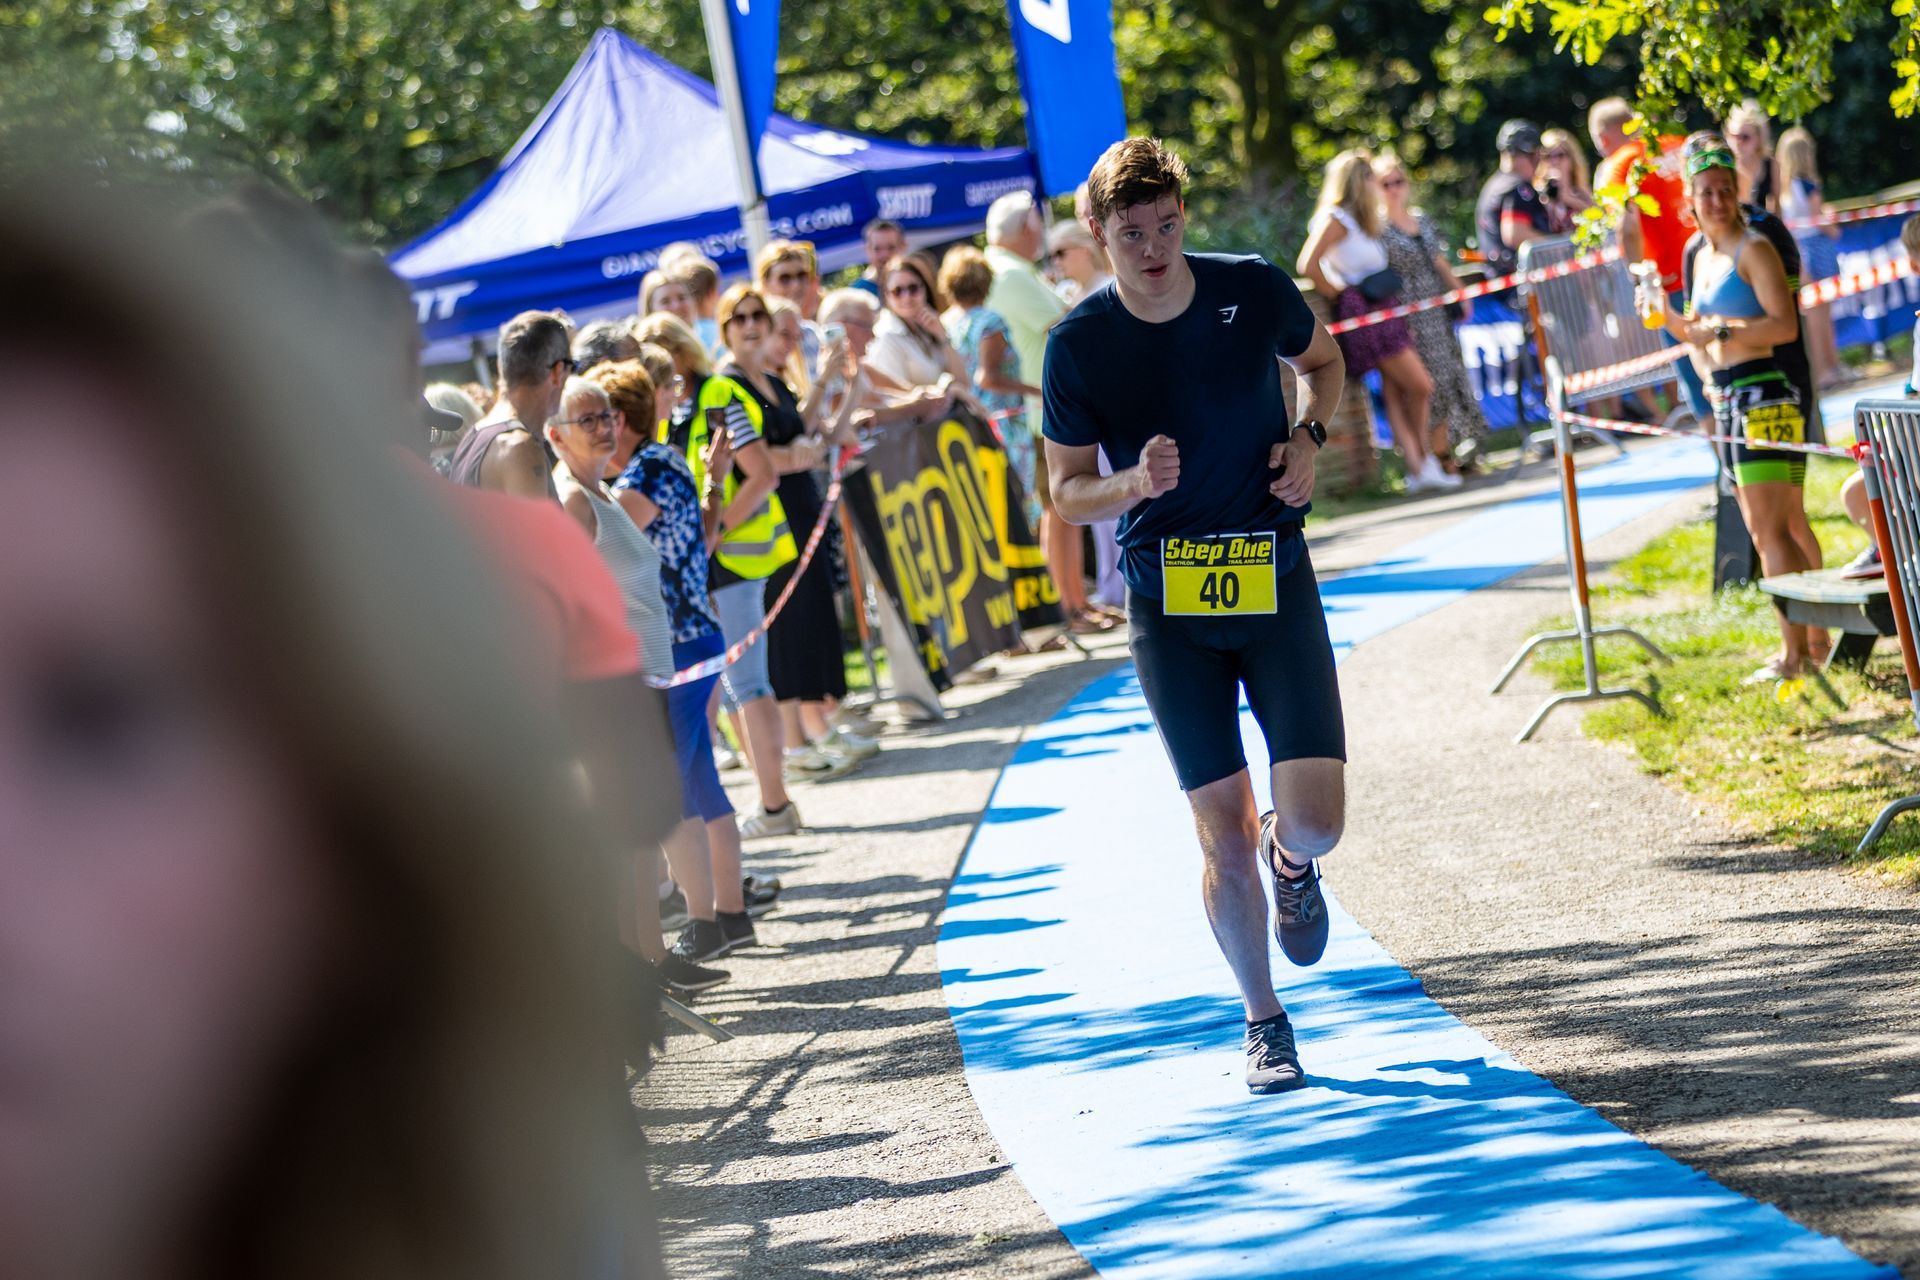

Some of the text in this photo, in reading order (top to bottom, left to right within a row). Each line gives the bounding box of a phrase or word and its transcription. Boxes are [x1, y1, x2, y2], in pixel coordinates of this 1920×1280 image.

[1165, 538, 1272, 565] Step One
[1200, 571, 1240, 610] 40
